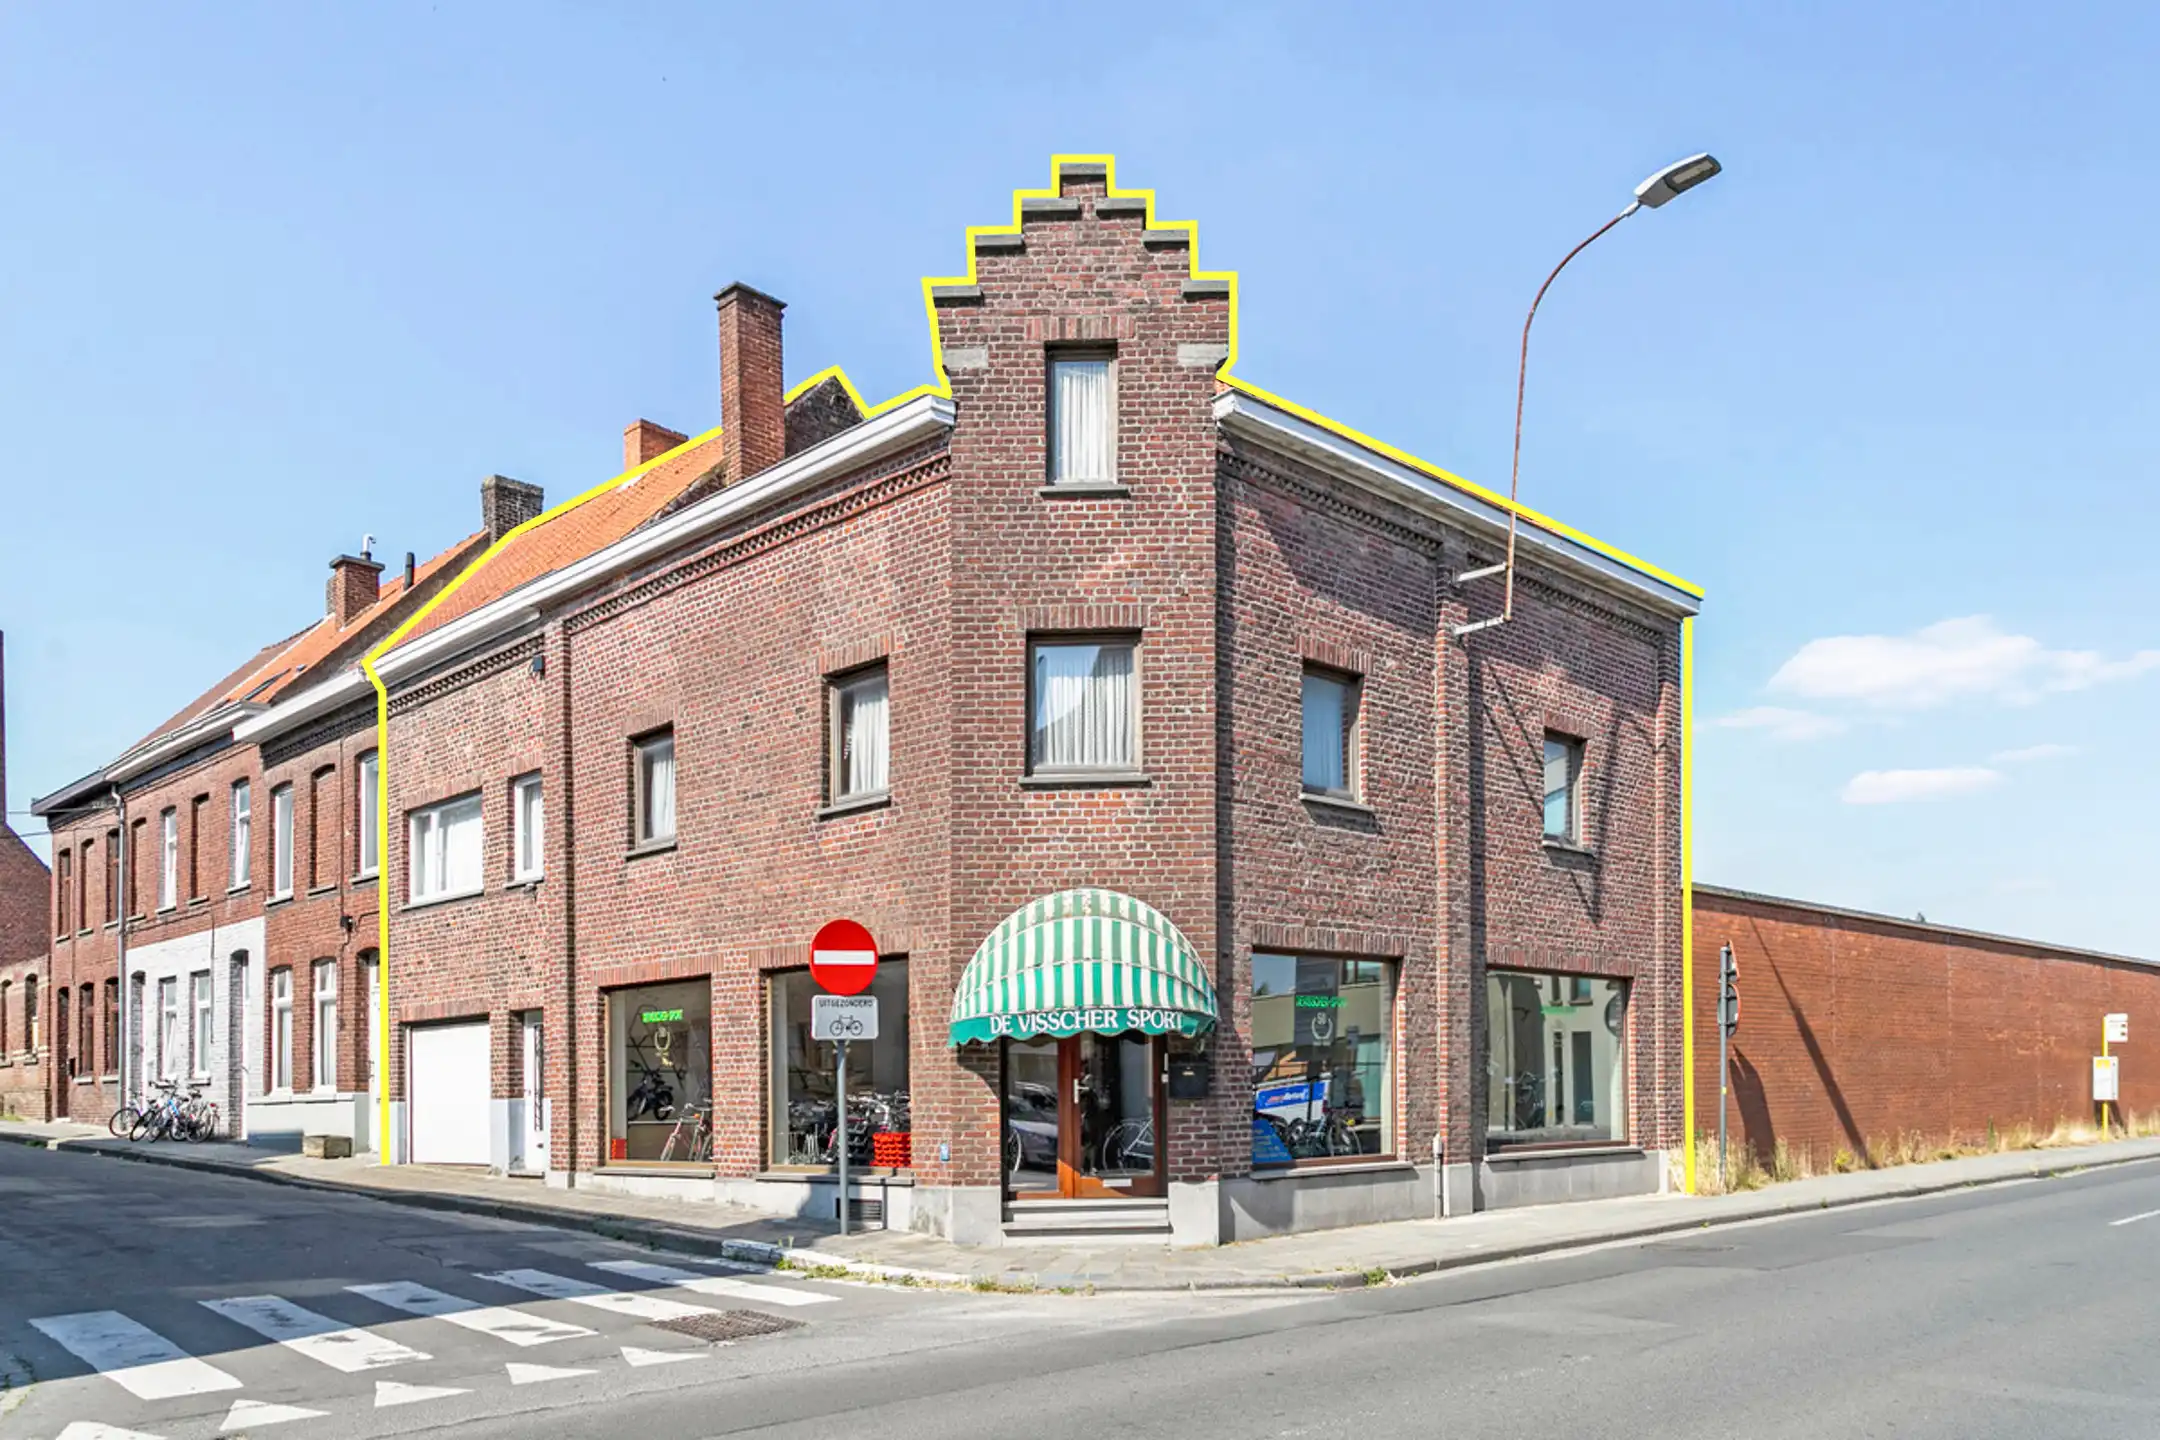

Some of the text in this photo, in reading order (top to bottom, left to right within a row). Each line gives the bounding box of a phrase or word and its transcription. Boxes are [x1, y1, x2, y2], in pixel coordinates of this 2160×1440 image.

[819, 998, 873, 1008] UITGEZONDERD
[990, 1009, 1182, 1034] DE VISSCHER SPORT
